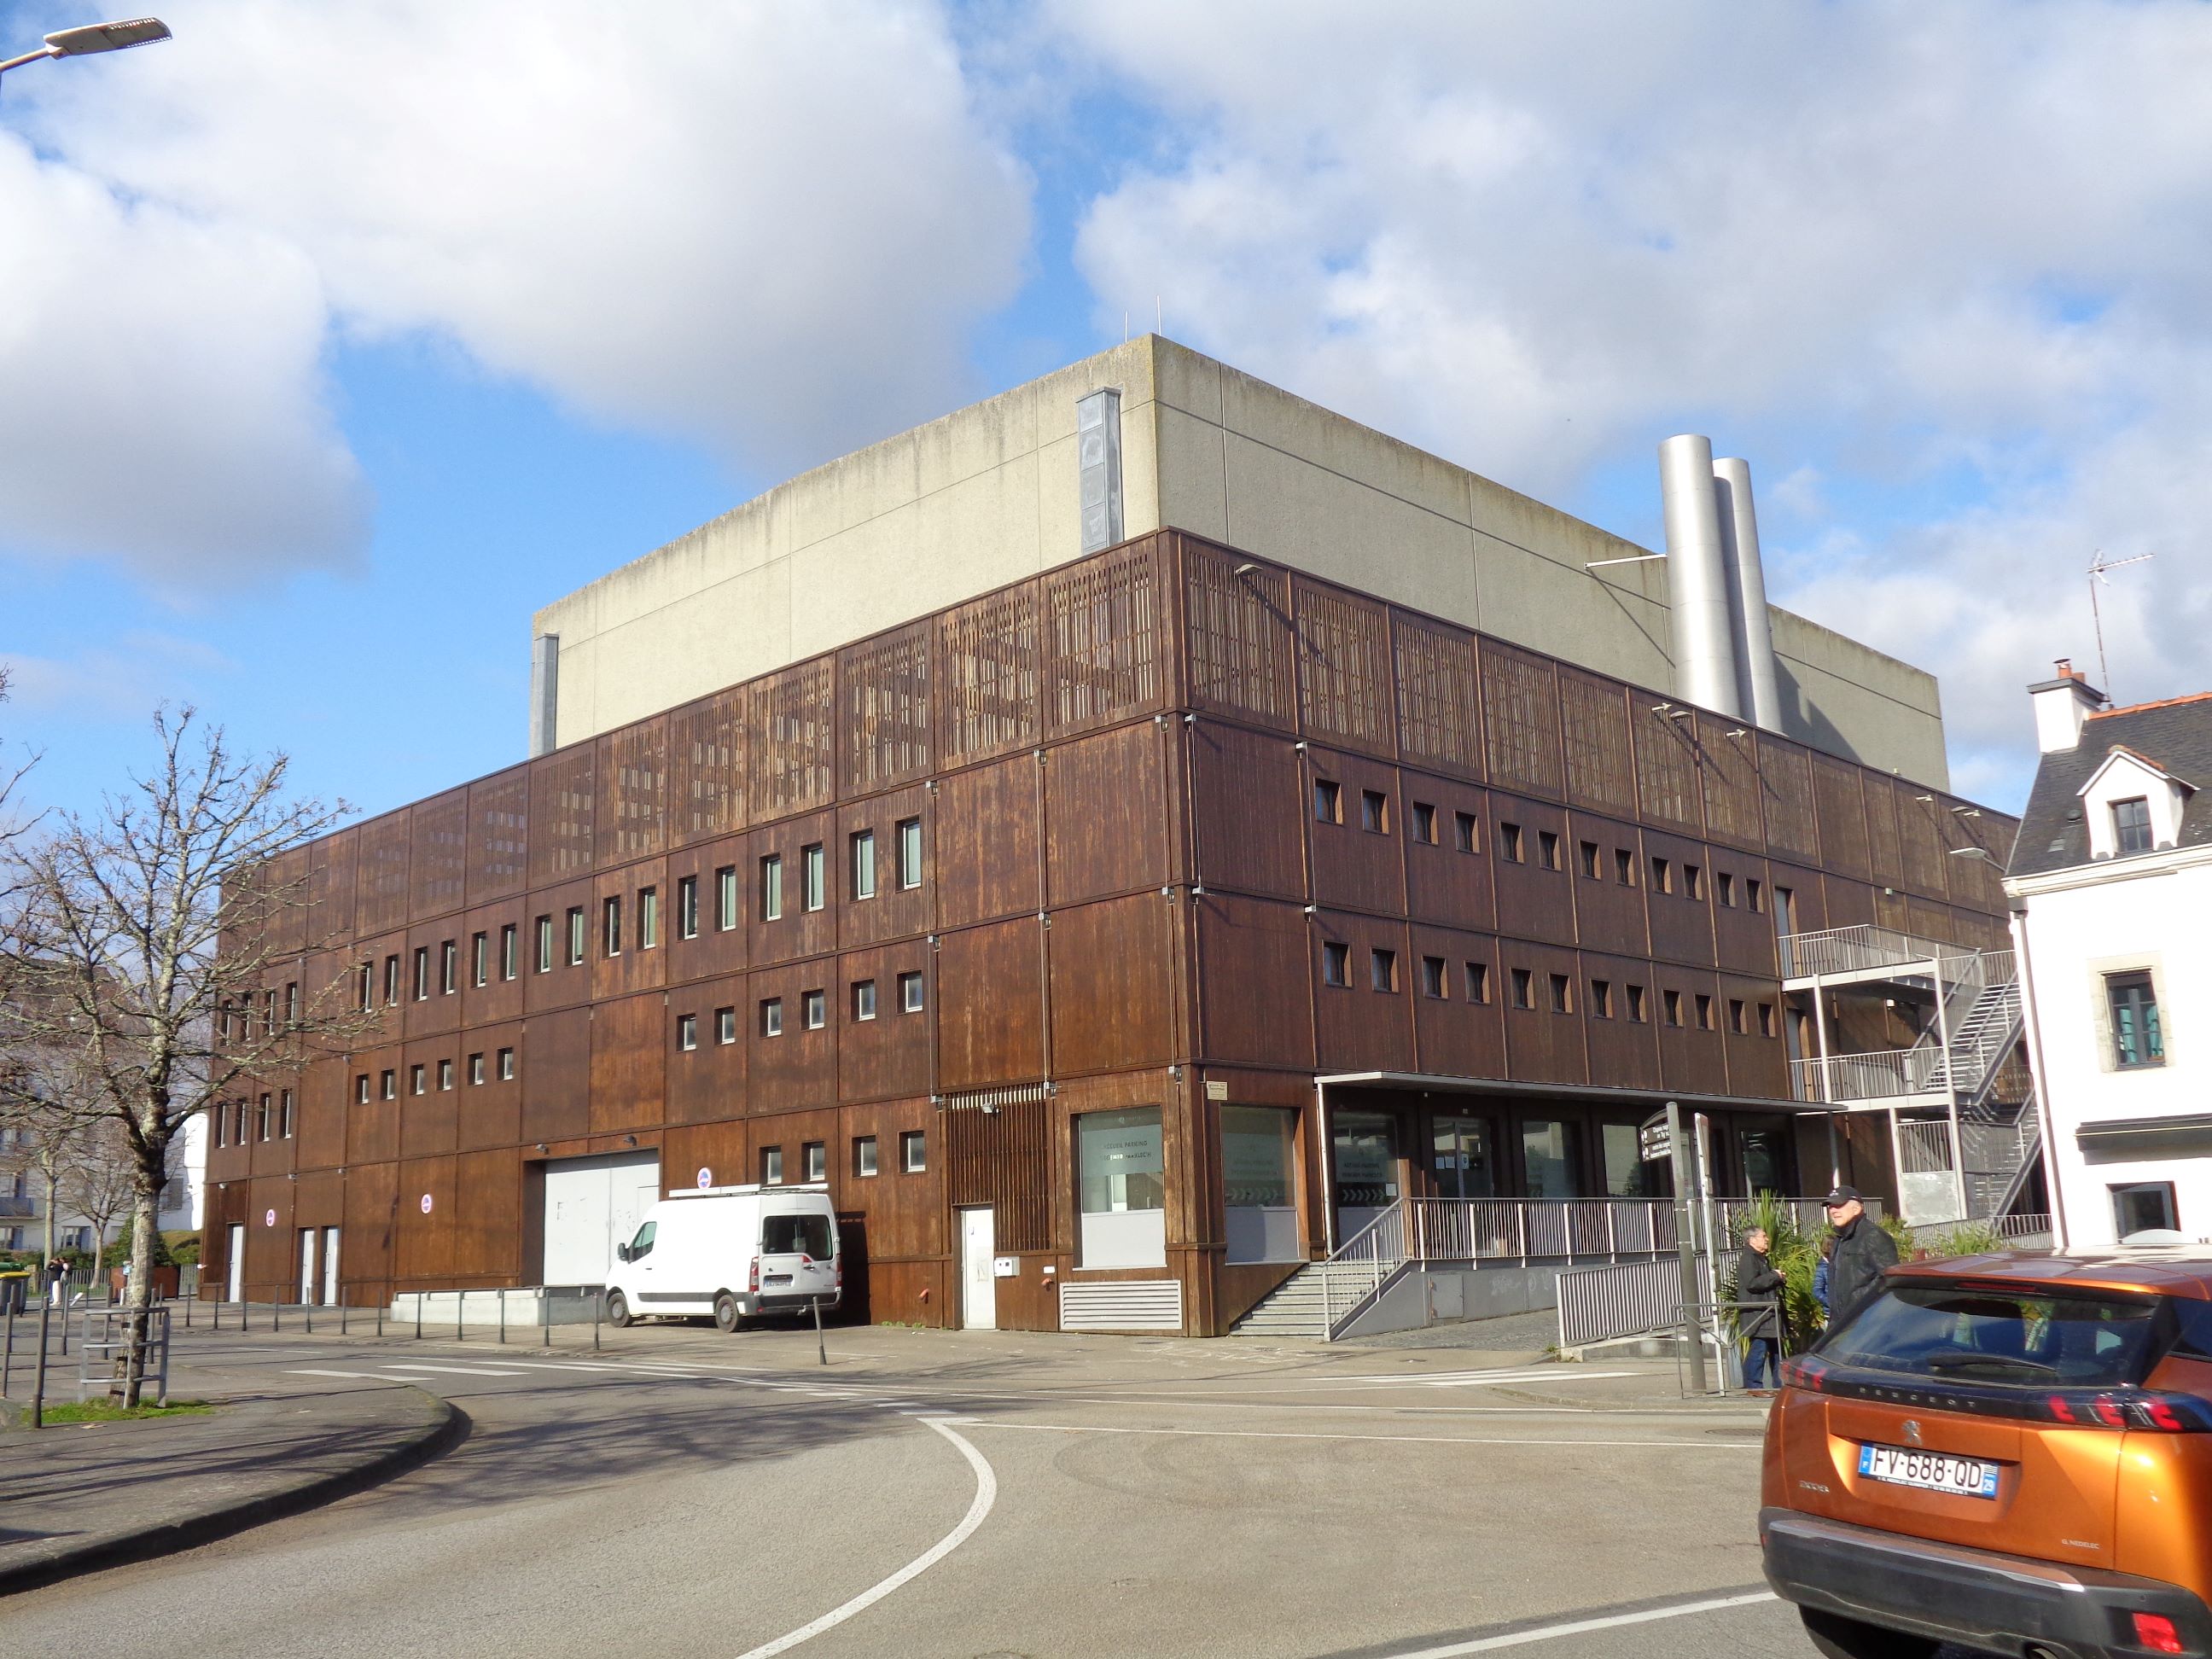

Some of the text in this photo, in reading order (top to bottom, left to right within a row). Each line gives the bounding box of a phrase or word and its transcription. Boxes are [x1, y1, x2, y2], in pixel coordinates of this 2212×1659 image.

[1859, 1387, 1976, 1407] PEUGEOT
[1873, 1447, 1982, 1488] FV-688-QD
[1983, 1478, 1995, 1492] 29
